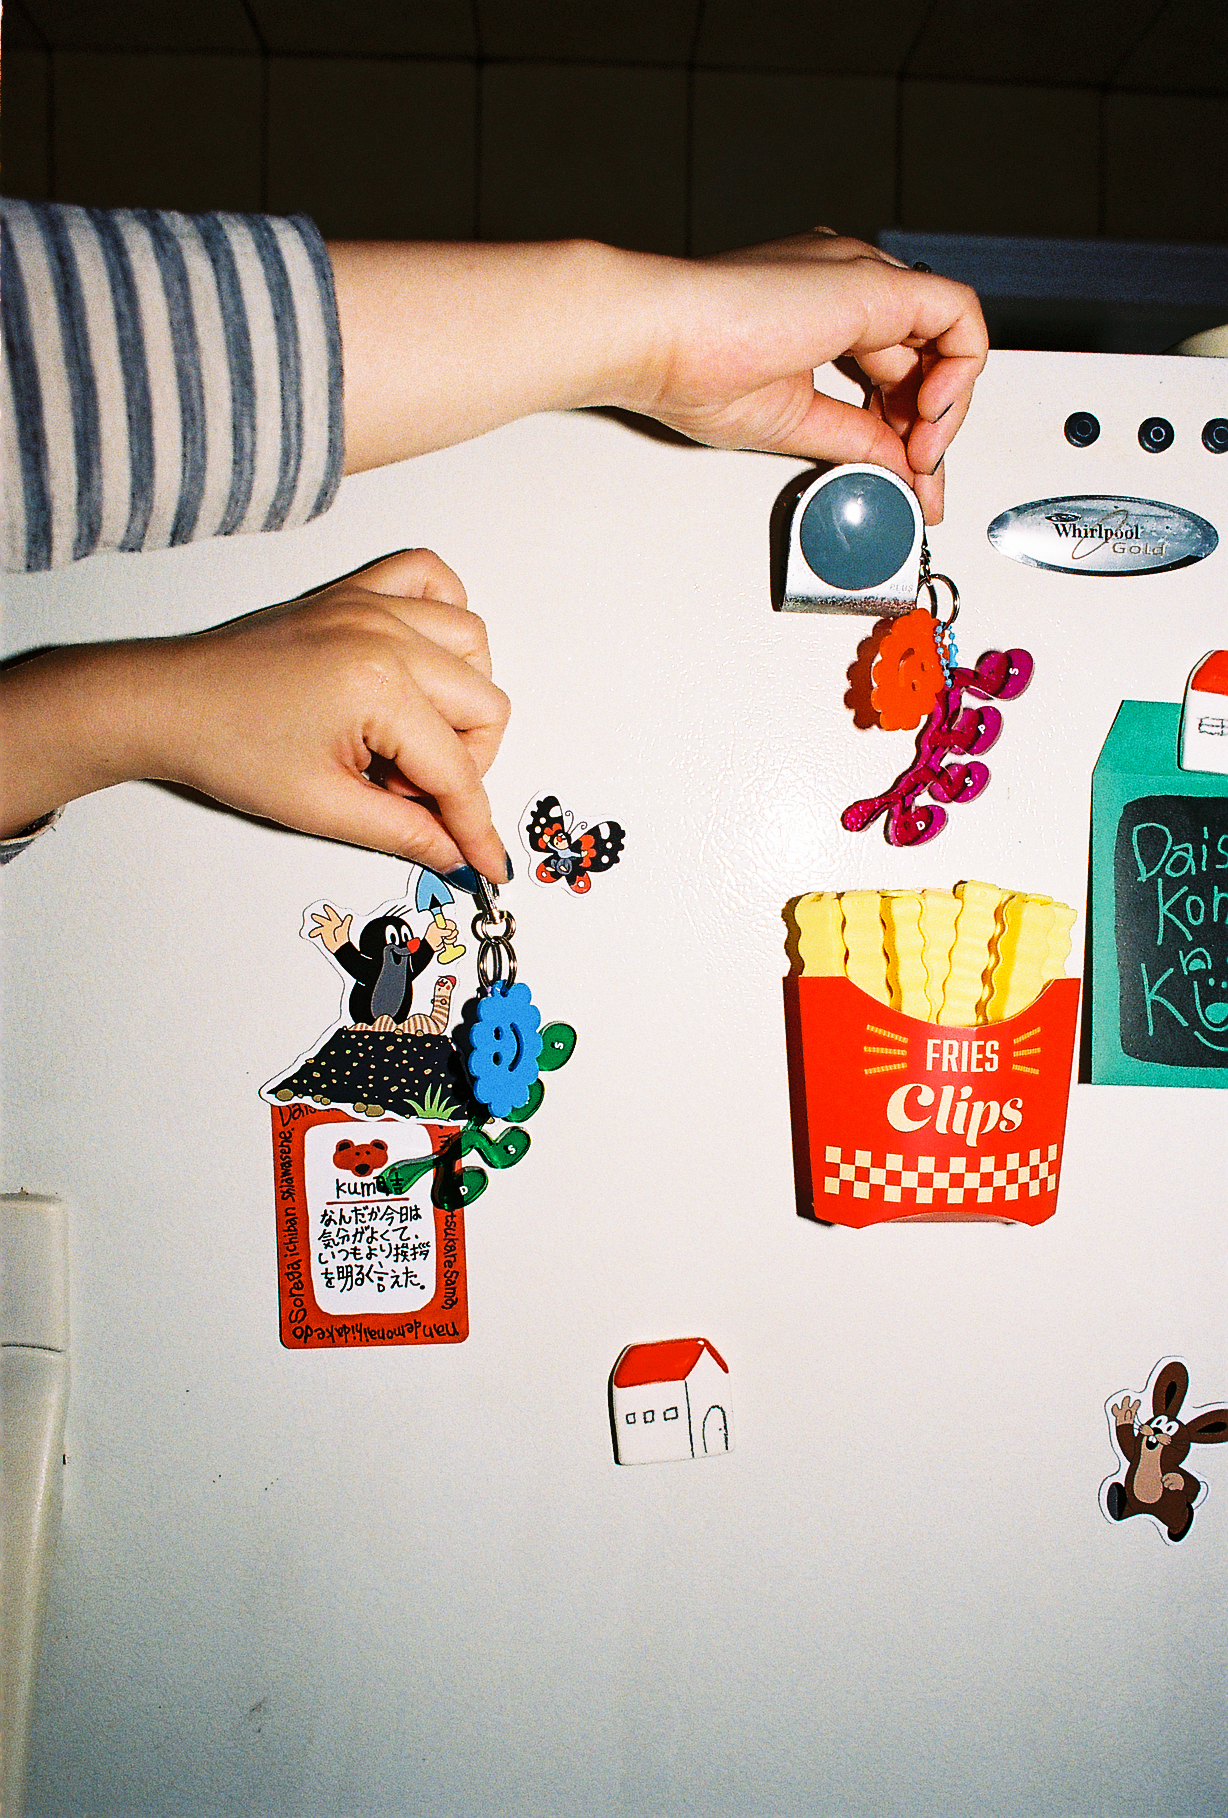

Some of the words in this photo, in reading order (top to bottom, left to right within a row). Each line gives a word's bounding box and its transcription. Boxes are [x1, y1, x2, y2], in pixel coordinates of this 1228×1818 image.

[1053, 522, 1140, 543] Whirlpool
[1112, 541, 1167, 556] Gold
[926, 1038, 1000, 1073] FRIES
[886, 1083, 1023, 1147] Clips
[319, 1204, 423, 1227] なんだか今日は
[317, 1241, 431, 1265] いつもより挨拶
[320, 1261, 426, 1293] を明るく言えた。
